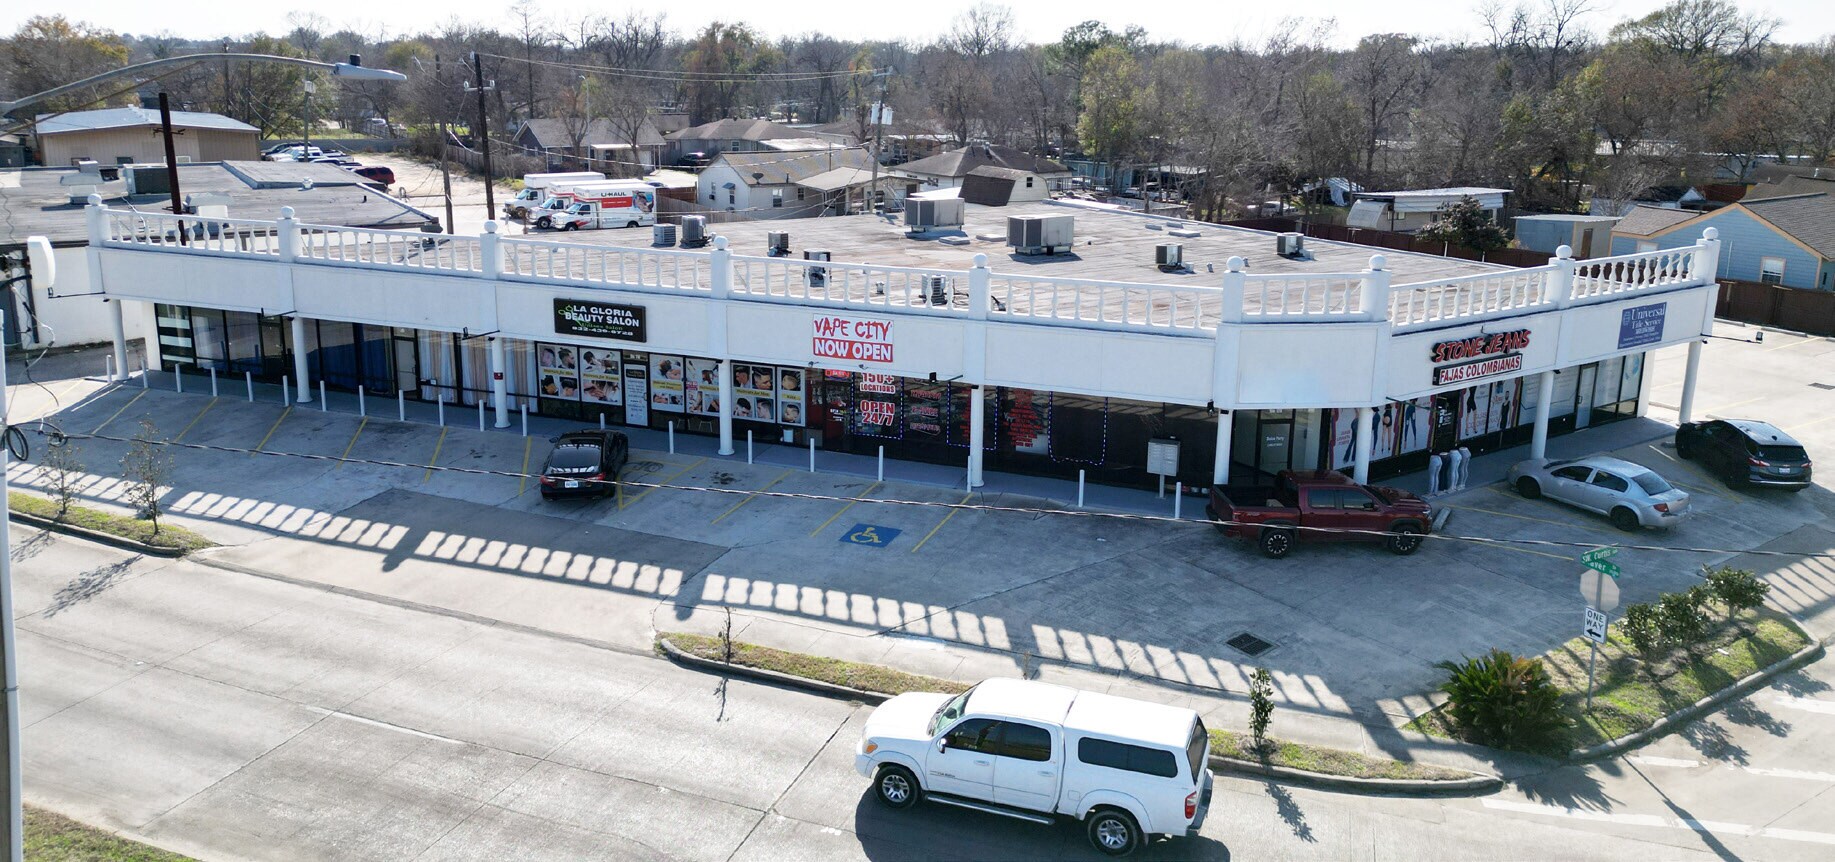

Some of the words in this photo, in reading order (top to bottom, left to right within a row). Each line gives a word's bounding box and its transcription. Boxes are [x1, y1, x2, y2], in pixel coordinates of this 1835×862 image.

[574, 305, 587, 313] LA
[590, 307, 633, 317] GLORIA
[1632, 303, 1666, 321] Universal
[565, 312, 604, 323] BEAUTY
[606, 316, 640, 327] SALON
[814, 317, 851, 337] VAPE
[855, 320, 891, 341] CITY
[814, 338, 849, 357] NOW
[852, 342, 892, 360] OPEN
[1435, 337, 1485, 363] STONE
[1485, 329, 1532, 355] JEANS
[1440, 366, 1464, 383] FAJAS
[1466, 356, 1521, 377] COLOMBIANAS
[861, 383, 895, 393] LOCATIONS
[861, 400, 895, 415] OPEN
[862, 412, 894, 426] 24/7
[1587, 610, 1604, 622] ONE
[1586, 618, 1604, 631] WAY
